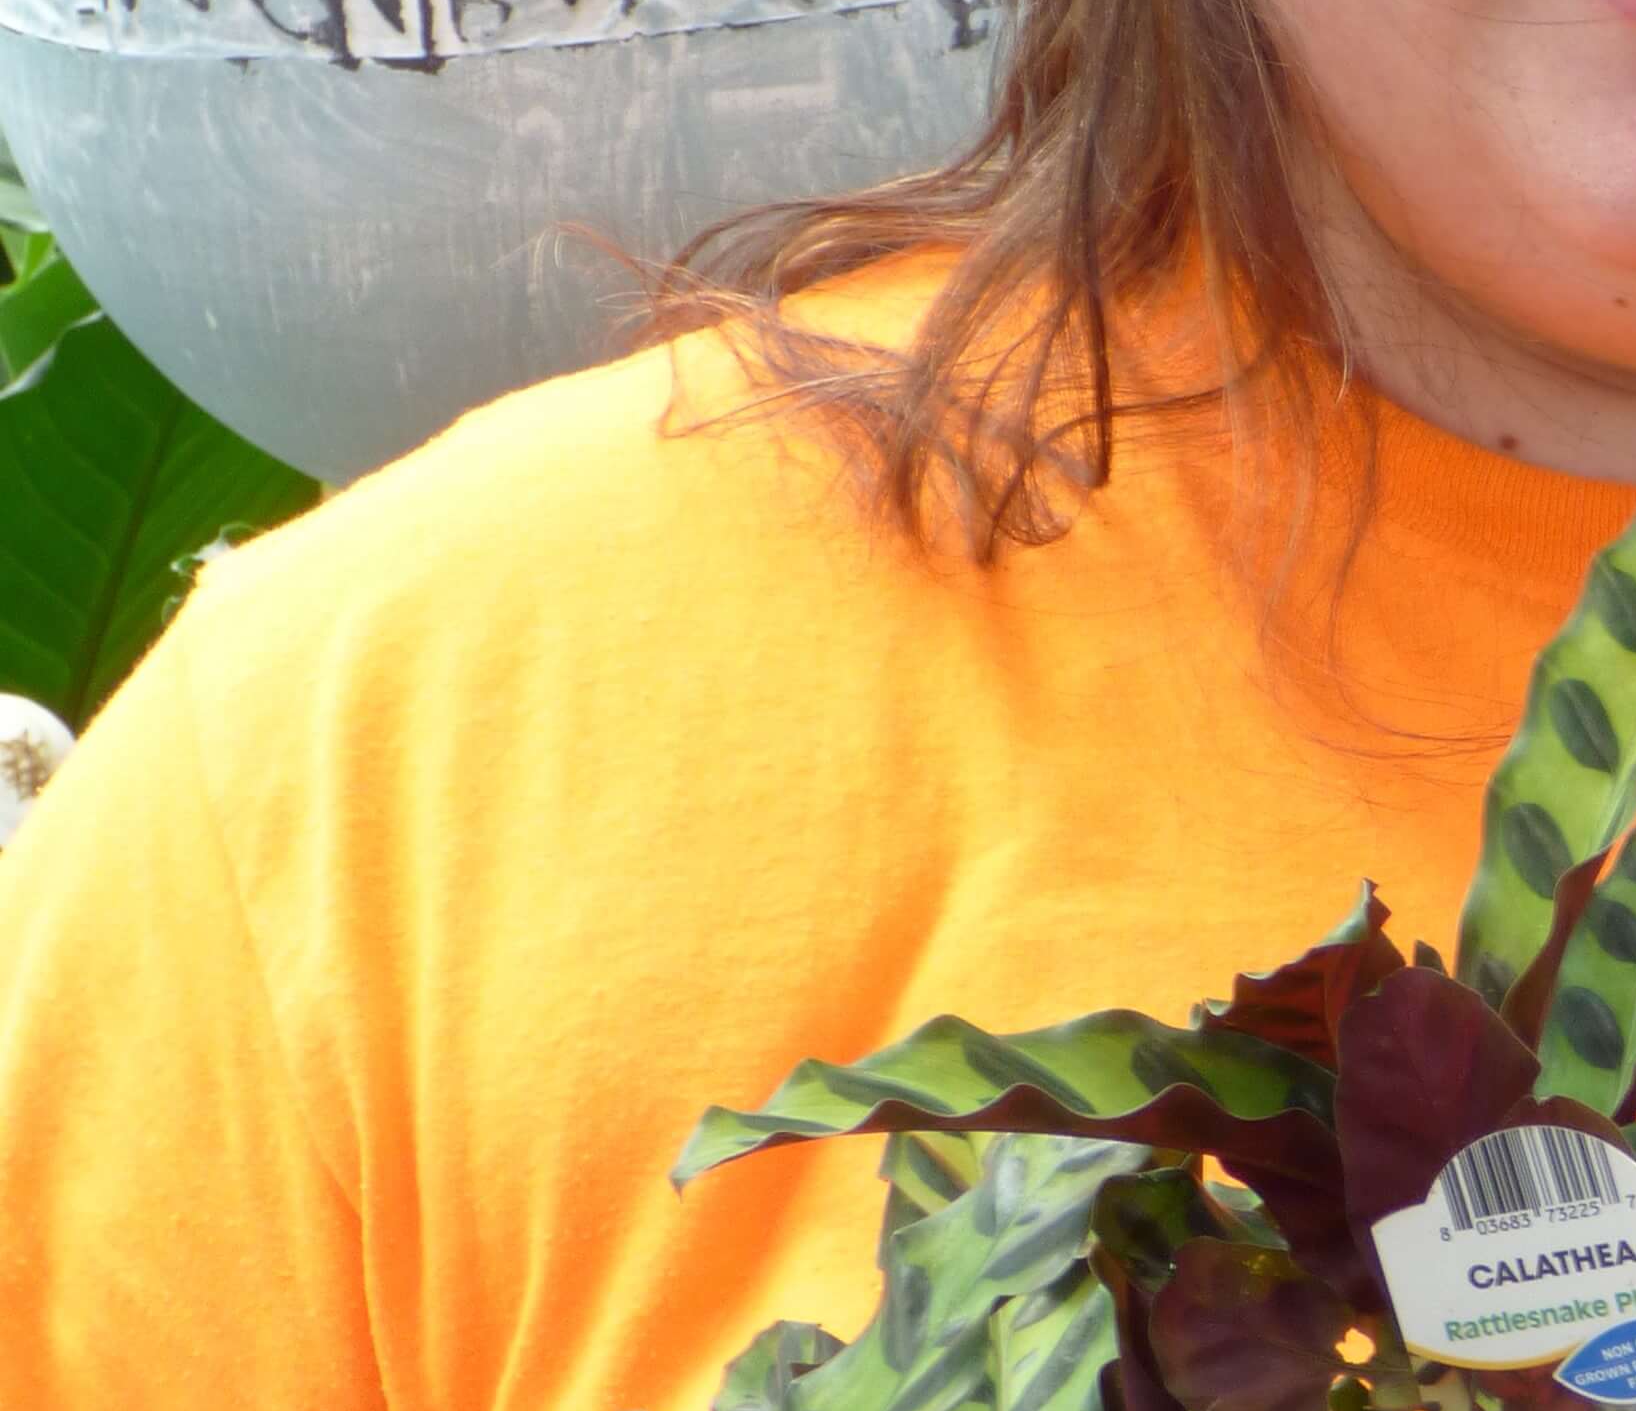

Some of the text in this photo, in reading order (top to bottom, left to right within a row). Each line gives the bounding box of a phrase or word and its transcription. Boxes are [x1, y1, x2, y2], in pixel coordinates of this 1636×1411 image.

[1439, 1193, 1636, 1242] 8 03683 73225 7
[1443, 1297, 1610, 1342] Rattlesnake
[1601, 1340, 1634, 1361] NON
[1574, 1362, 1632, 1386] GROWN
